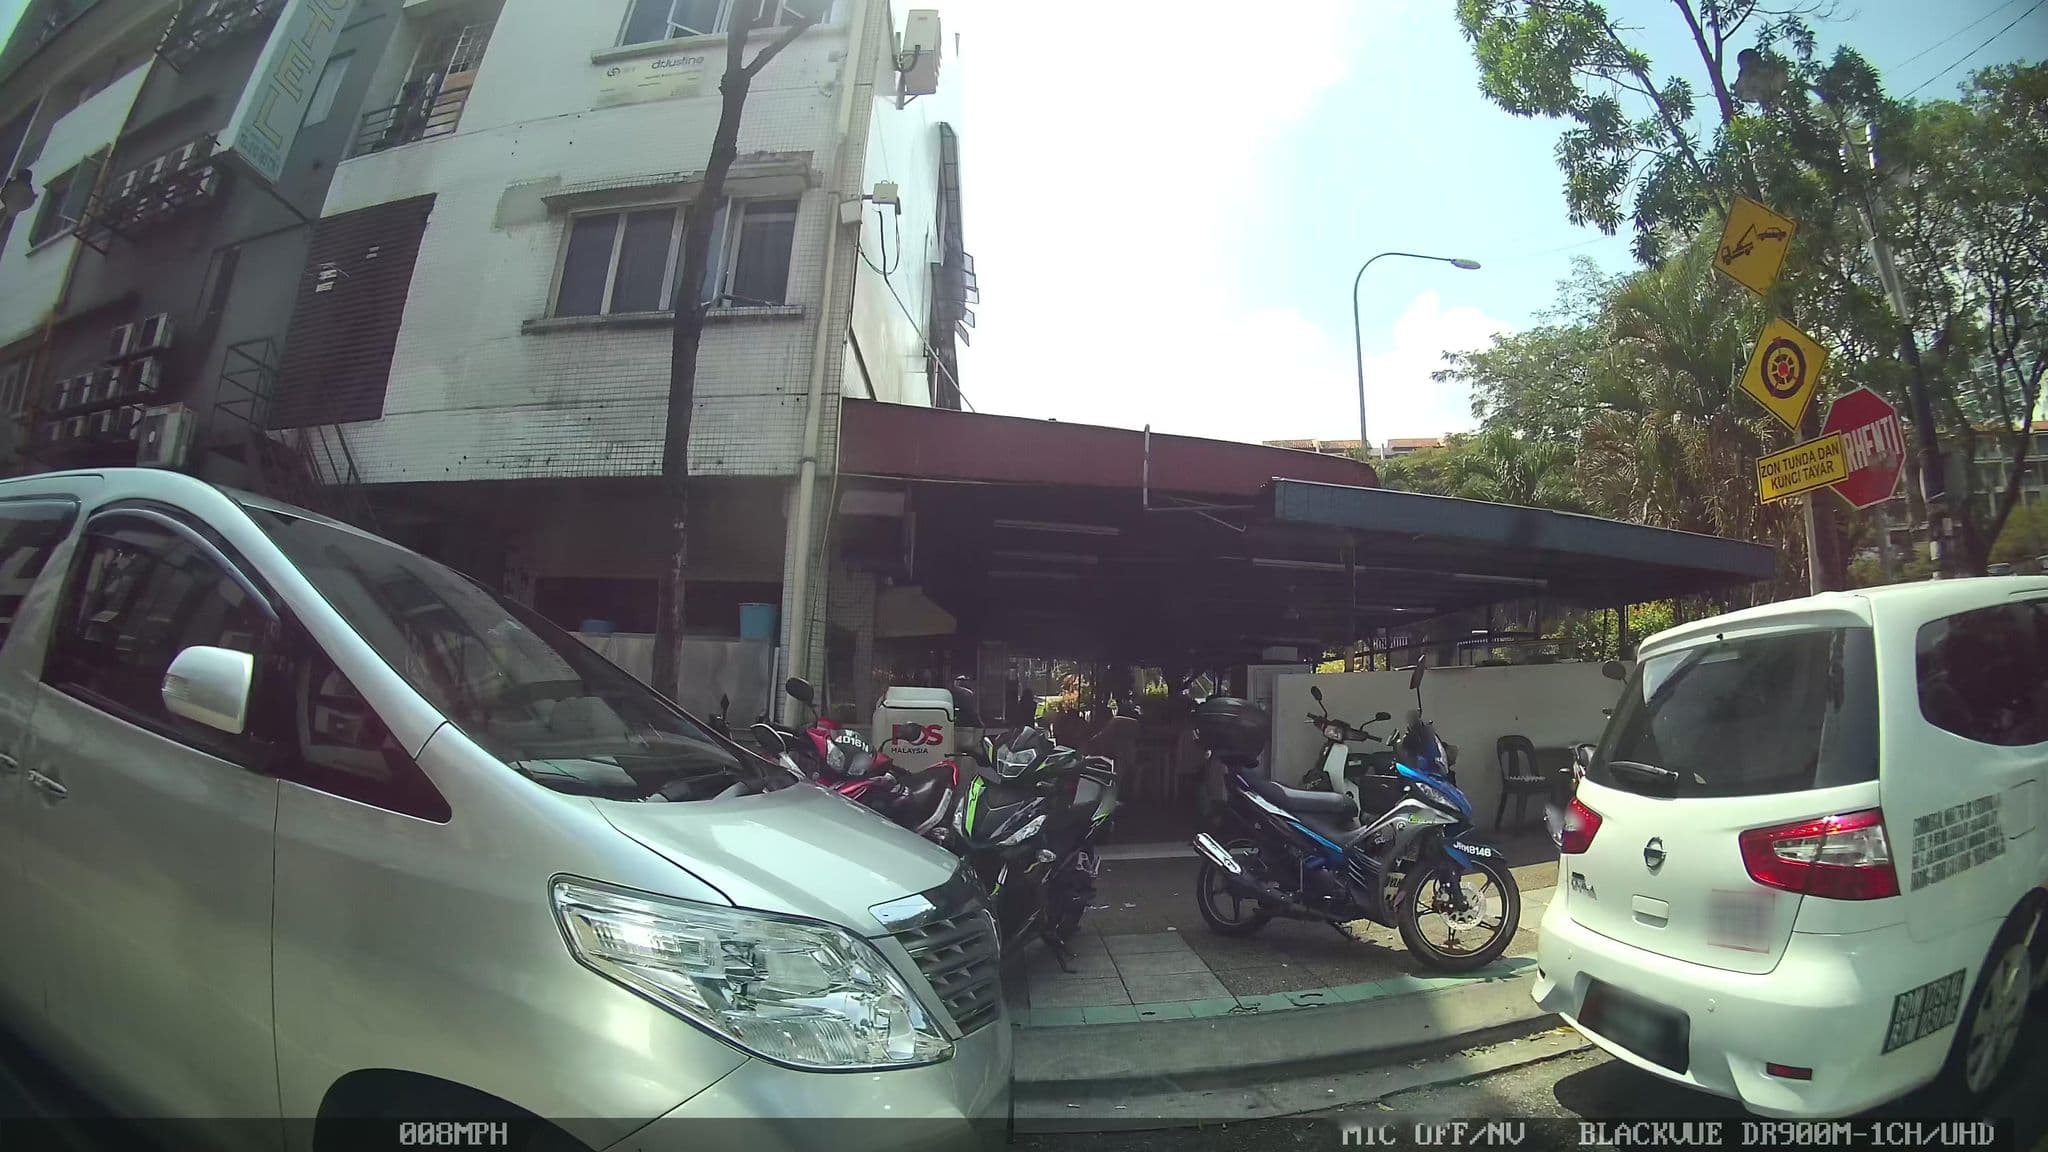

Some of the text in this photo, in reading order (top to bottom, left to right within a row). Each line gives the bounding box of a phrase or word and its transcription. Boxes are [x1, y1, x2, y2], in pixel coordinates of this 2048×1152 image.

[253, 0, 350, 149] TEL
[1760, 442, 1840, 479] ZON TUNDA DAN
[1842, 414, 1901, 473] RHENTI
[1771, 460, 1834, 490] KUNCI TAYAR
[891, 747, 929, 755] MALAYSIA
